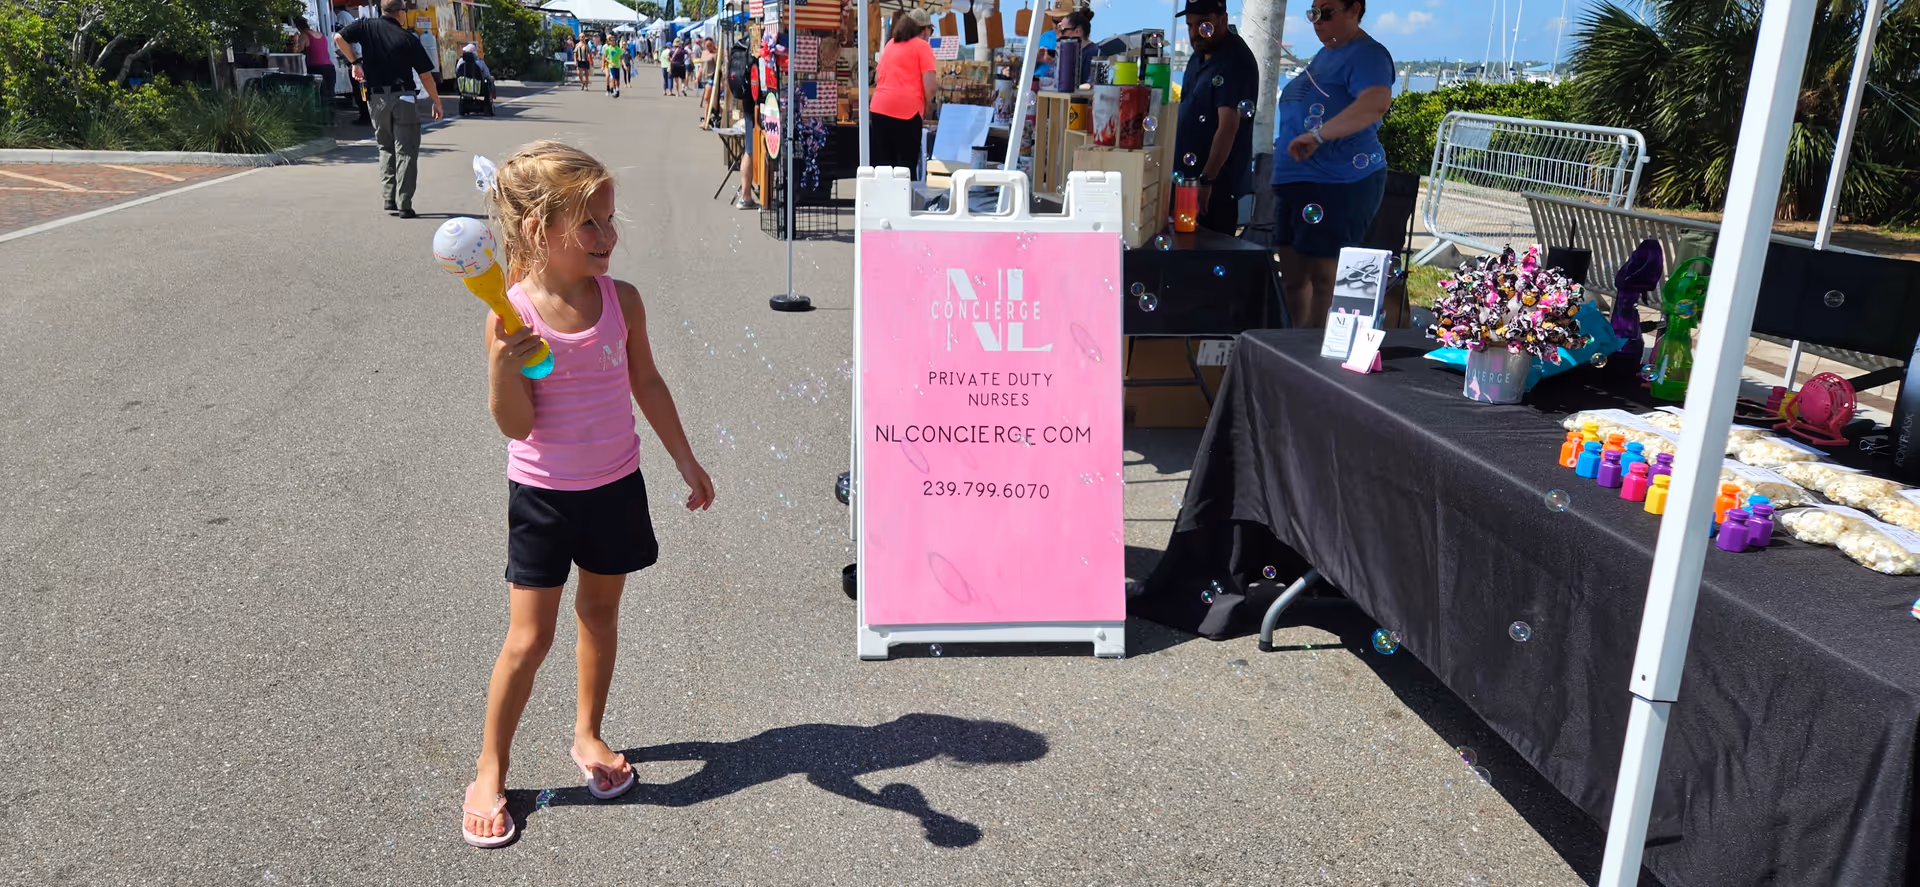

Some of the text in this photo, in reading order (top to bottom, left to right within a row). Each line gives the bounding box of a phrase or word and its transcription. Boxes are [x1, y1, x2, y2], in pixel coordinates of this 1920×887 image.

[931, 301, 1041, 320] CONCIERGE
[928, 371, 1053, 387] PRIVATE DUTY
[968, 393, 1029, 407] NURSES
[923, 480, 1050, 500] 239.799.6070
